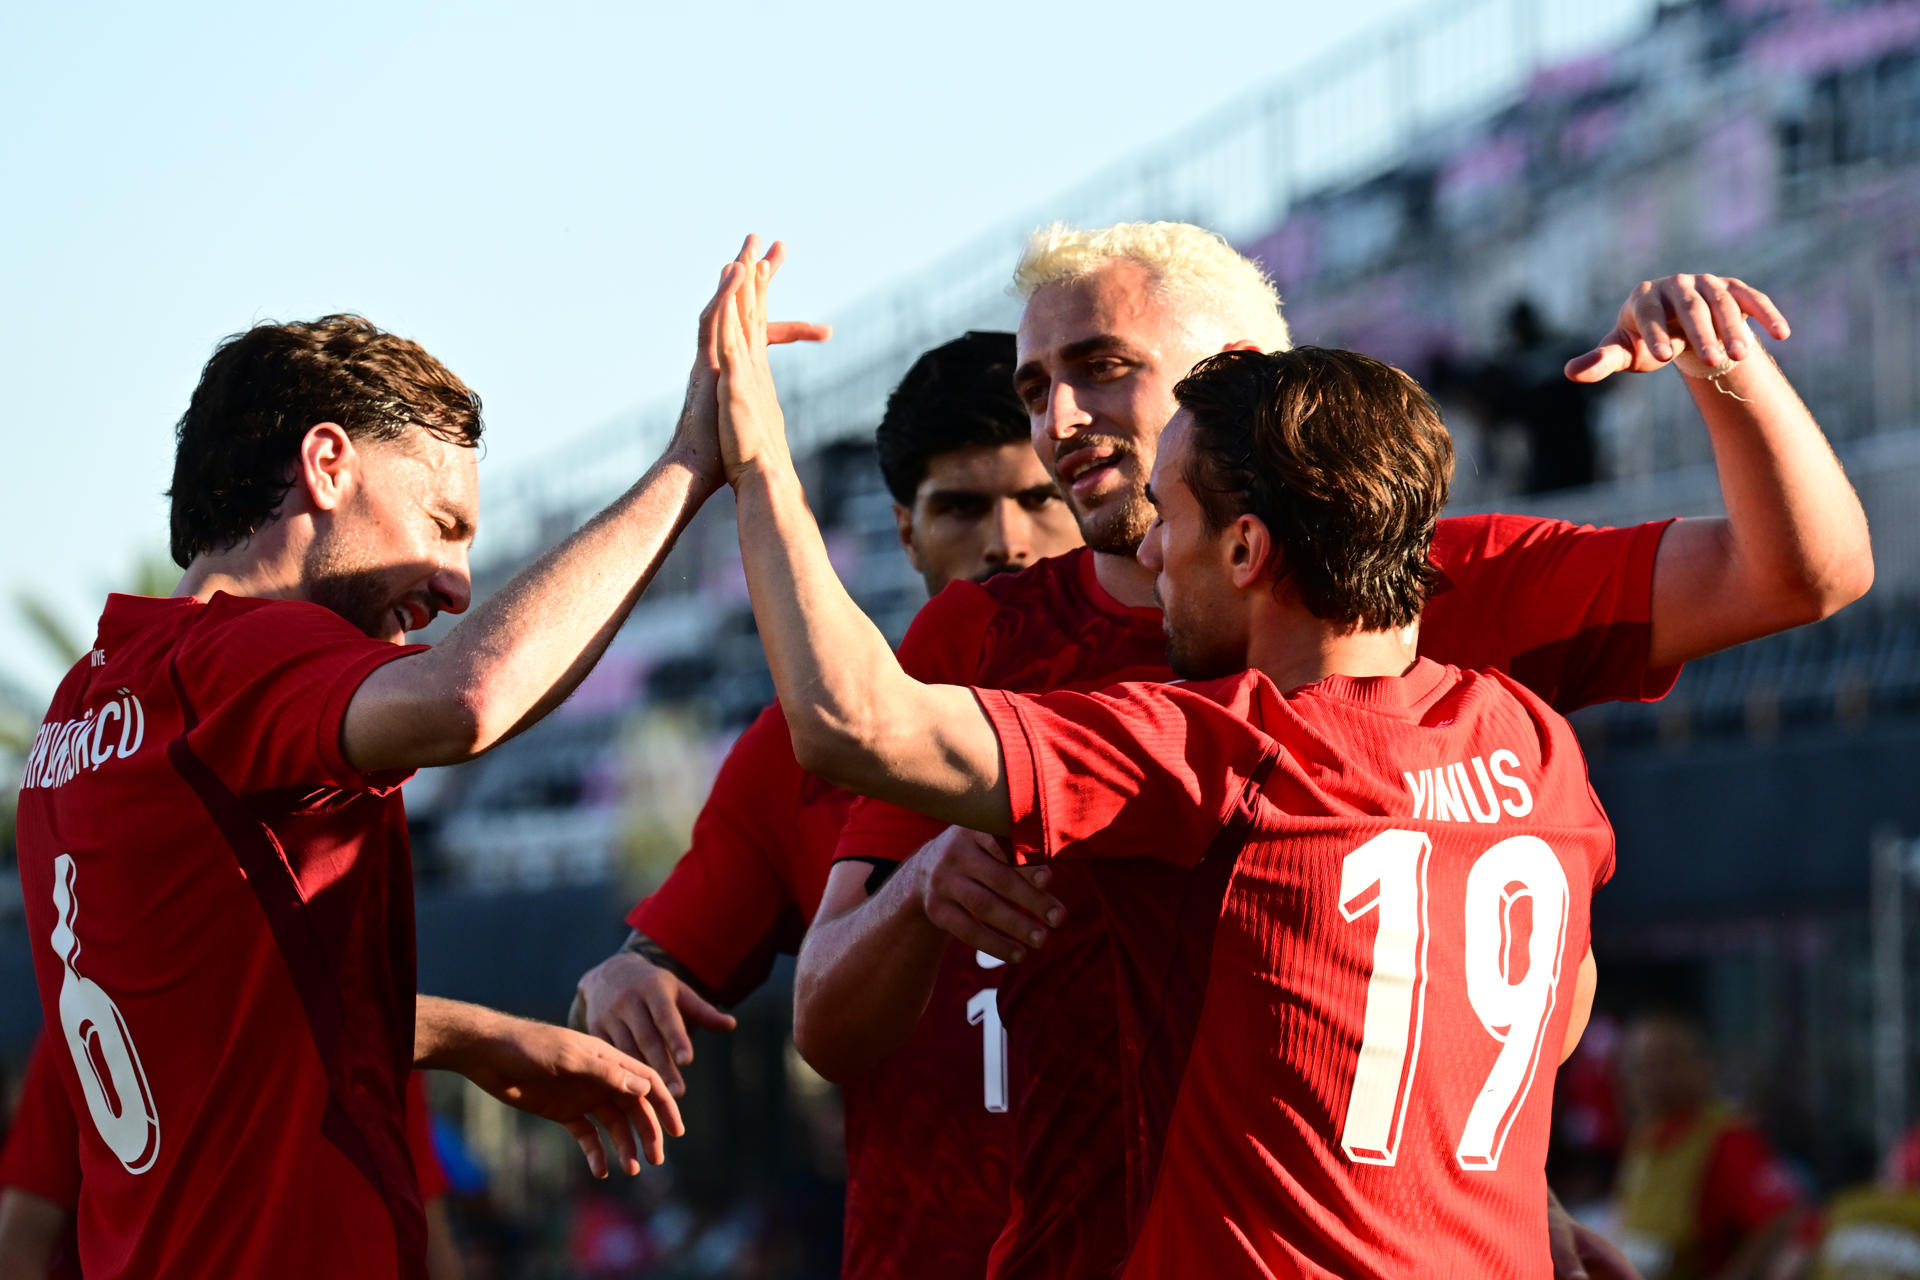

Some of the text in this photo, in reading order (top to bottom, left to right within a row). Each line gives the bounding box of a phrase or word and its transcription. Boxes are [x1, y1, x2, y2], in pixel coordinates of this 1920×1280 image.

[51, 853, 160, 1178] 6
[967, 988, 1008, 1113] 1
[1338, 829, 1569, 1171] 19
